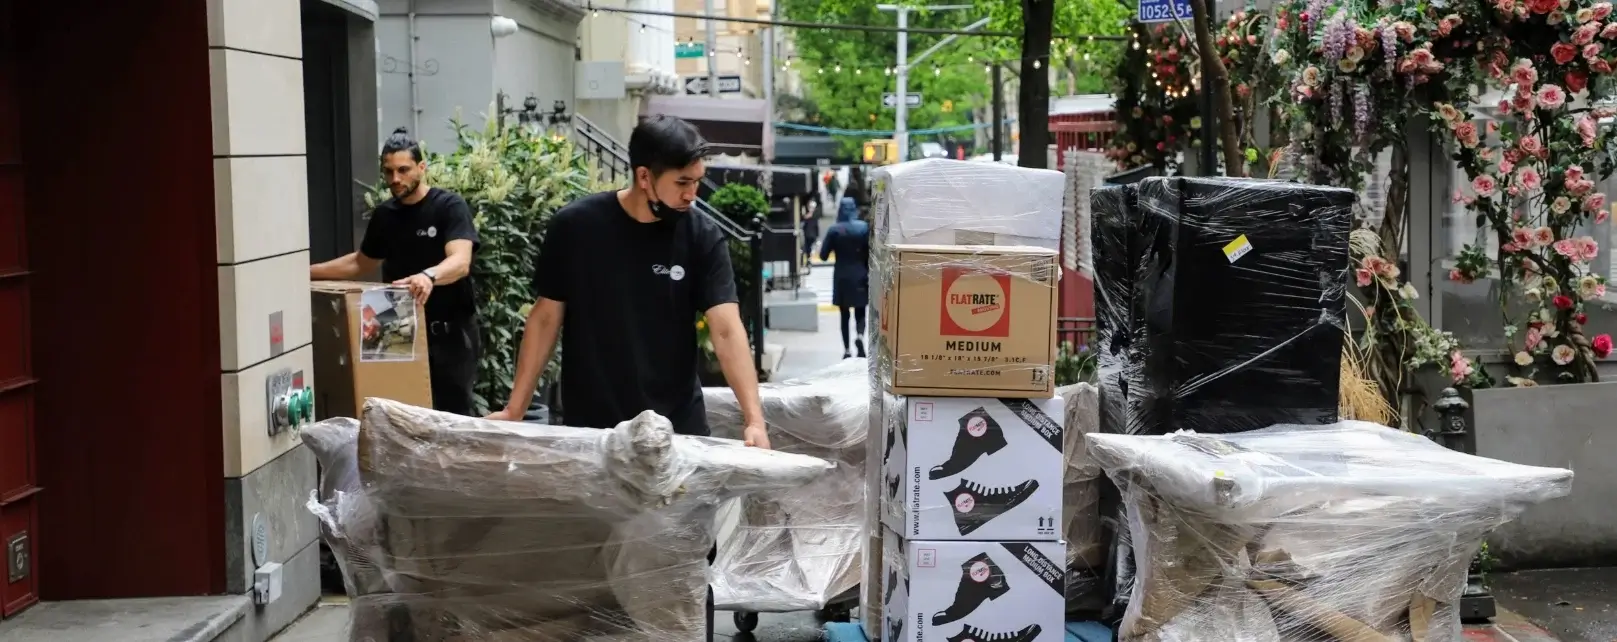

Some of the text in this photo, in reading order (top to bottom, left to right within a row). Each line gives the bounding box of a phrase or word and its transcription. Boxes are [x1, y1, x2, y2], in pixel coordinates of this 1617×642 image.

[950, 293, 996, 305] FLATRATE
[945, 340, 1002, 353] MEDIUM
[1020, 410, 1053, 439] MEDIUM BOX
[1035, 412, 1061, 436] DISTANCE
[1022, 554, 1055, 584] MEDIUM BOX
[1023, 545, 1062, 580] LONG DISTANCE
